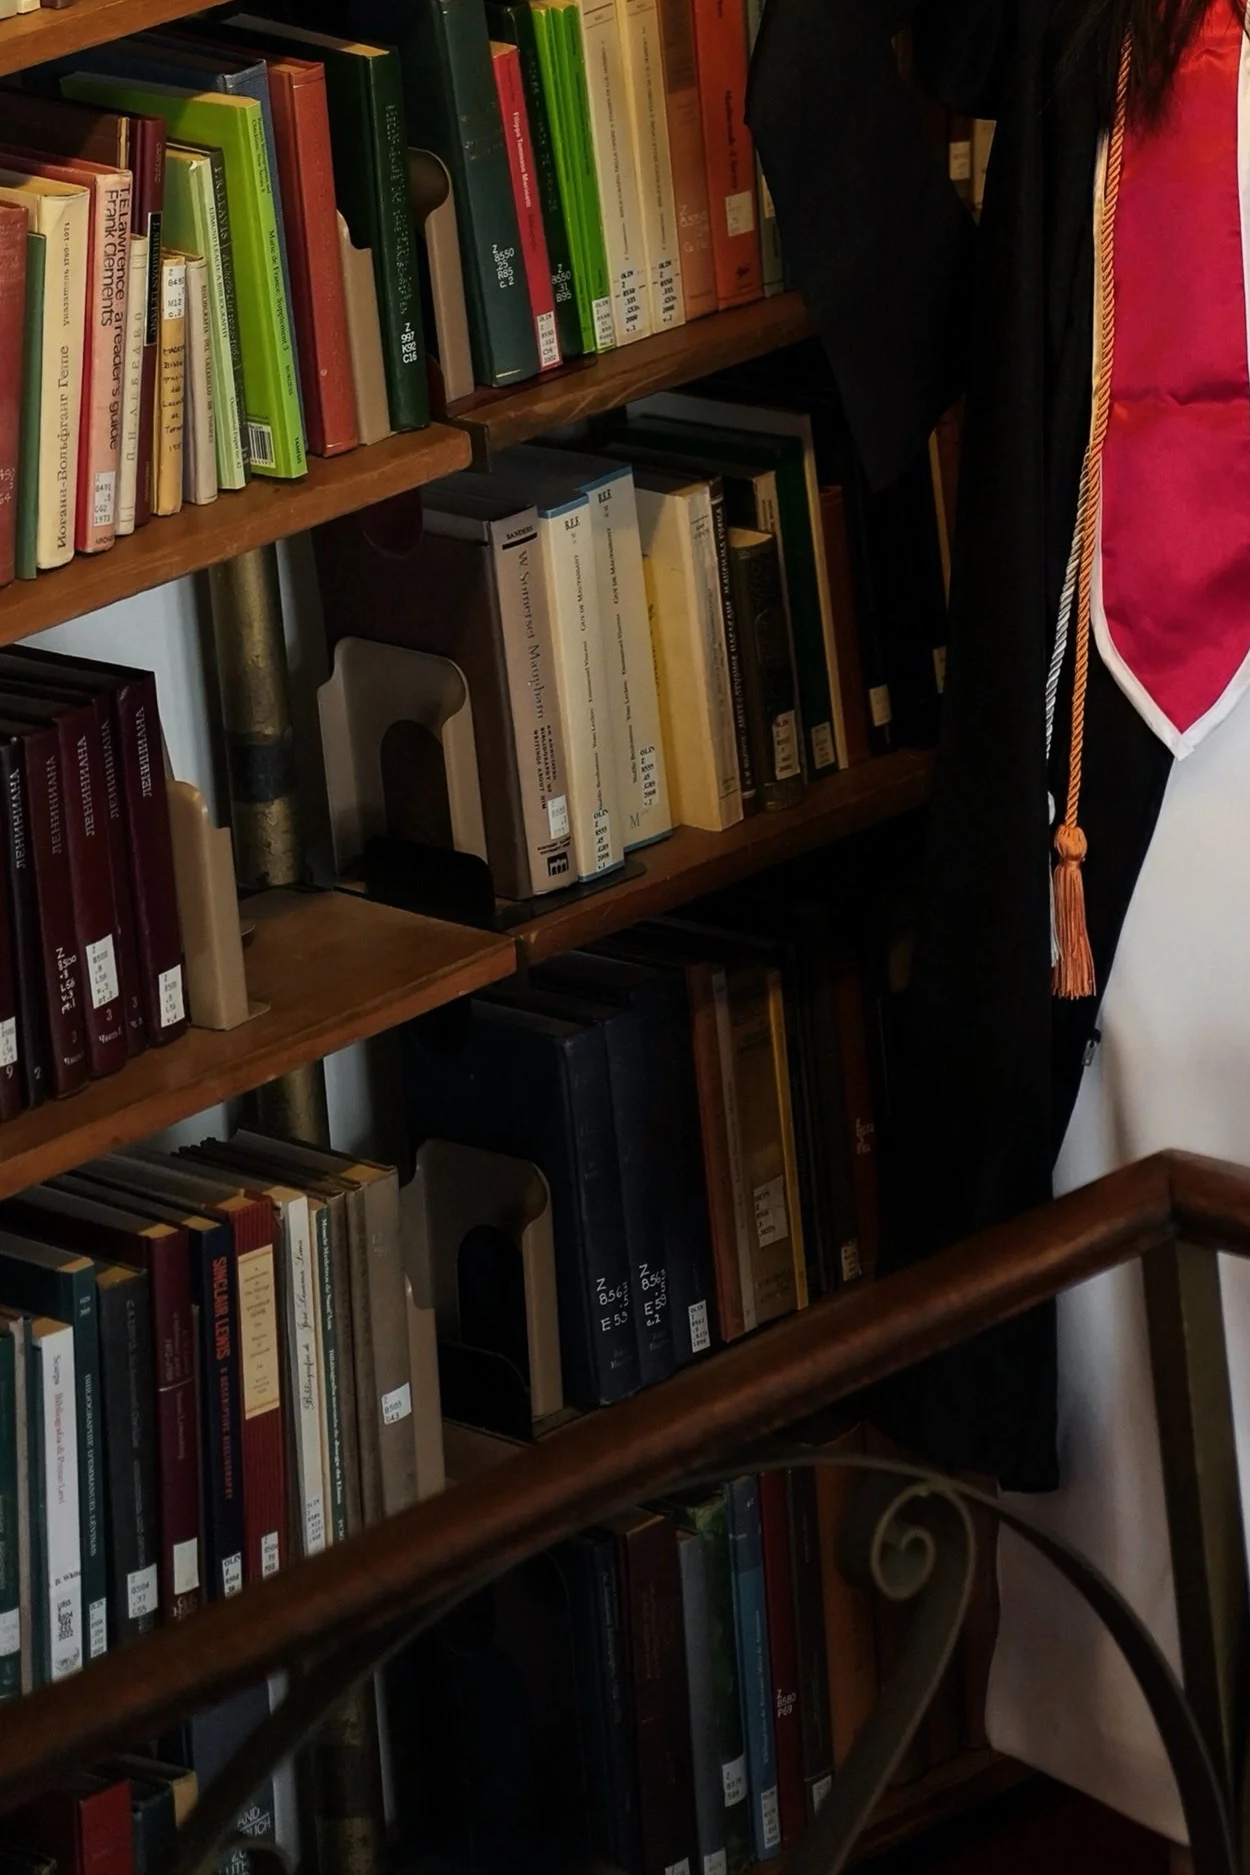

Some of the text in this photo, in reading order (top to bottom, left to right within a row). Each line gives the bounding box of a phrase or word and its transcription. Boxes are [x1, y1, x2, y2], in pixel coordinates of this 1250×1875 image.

[513, 112, 531, 207] Filippo Tommaso Marinetti
[100, 188, 120, 328] Frank Clements
[492, 245, 498, 254] Z
[494, 248, 514, 263] 8550
[268, 229, 288, 342] Marie Supplement
[552, 271, 571, 285] 8550
[217, 282, 228, 338] BIBLIOGRAPHY
[556, 291, 571, 302] B95
[401, 332, 414, 342] 997
[405, 323, 411, 332] Z
[402, 342, 416, 353] K92
[403, 353, 417, 363] C16
[109, 325, 123, 450] reader's guide
[506, 525, 533, 540] SANDERS
[606, 527, 616, 575] MAUPASSANT
[573, 554, 583, 601] MAUPASSANT
[520, 572, 545, 720] Somerset Maugham
[135, 707, 152, 797] ЛЕНИНИАНА
[533, 729, 545, 792] WRITINGS ABOUT
[540, 727, 551, 781] BIBLIOGRAPHY
[77, 733, 95, 837] ЛЕНИНИАНА
[10, 768, 26, 869] ЛЕНИНИАНА
[47, 755, 61, 855] ЛЕНИНИАНА
[56, 948, 64, 959] Z
[58, 955, 77, 971] 8500
[61, 979, 75, 992] L56
[62, 990, 74, 1001] v.3
[596, 1278, 606, 1292] Z
[639, 1264, 650, 1277] Z
[641, 1269, 666, 1290] 8563
[213, 1256, 231, 1361] SINCLAIR LEWIS
[599, 1281, 628, 1305] 8563
[52, 1355, 65, 1446] Scarpa Bibliografia
[84, 1372, 93, 1442] BIBLIOGRAPHIE
